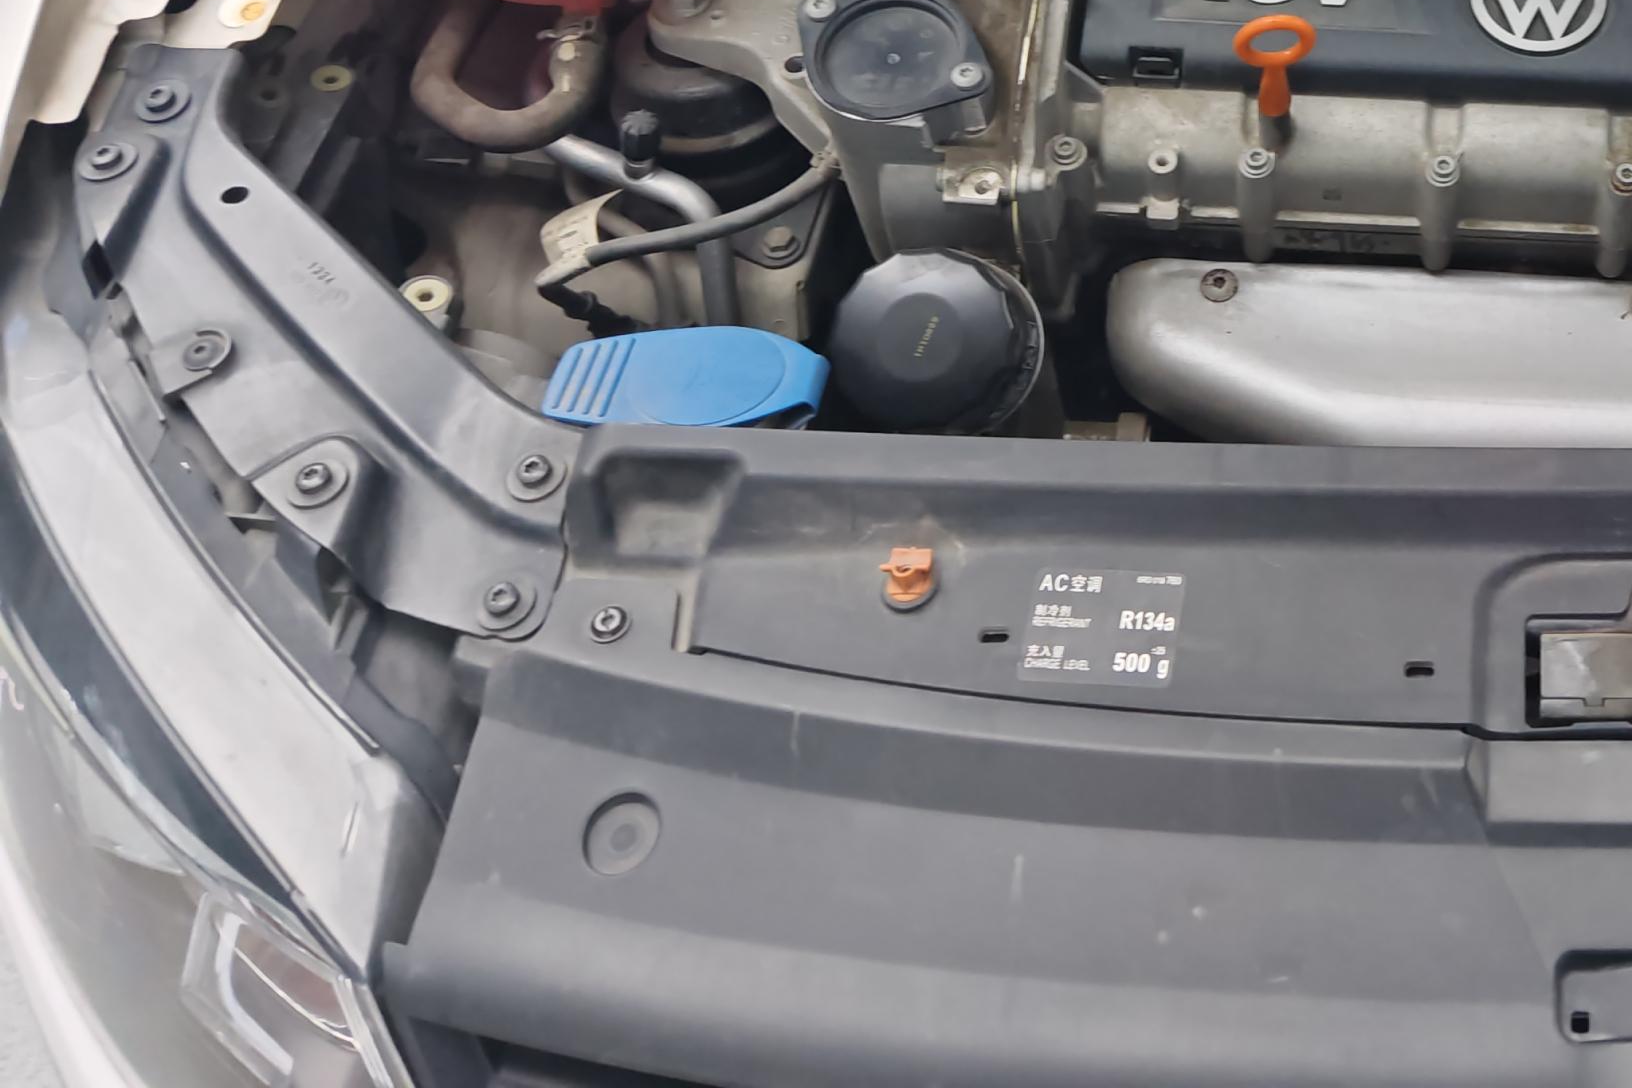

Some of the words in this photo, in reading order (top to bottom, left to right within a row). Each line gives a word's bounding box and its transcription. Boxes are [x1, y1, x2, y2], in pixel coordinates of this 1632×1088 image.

[1119, 610, 1176, 632] R134a
[1112, 652, 1151, 673] 500
[1156, 659, 1170, 679] g
